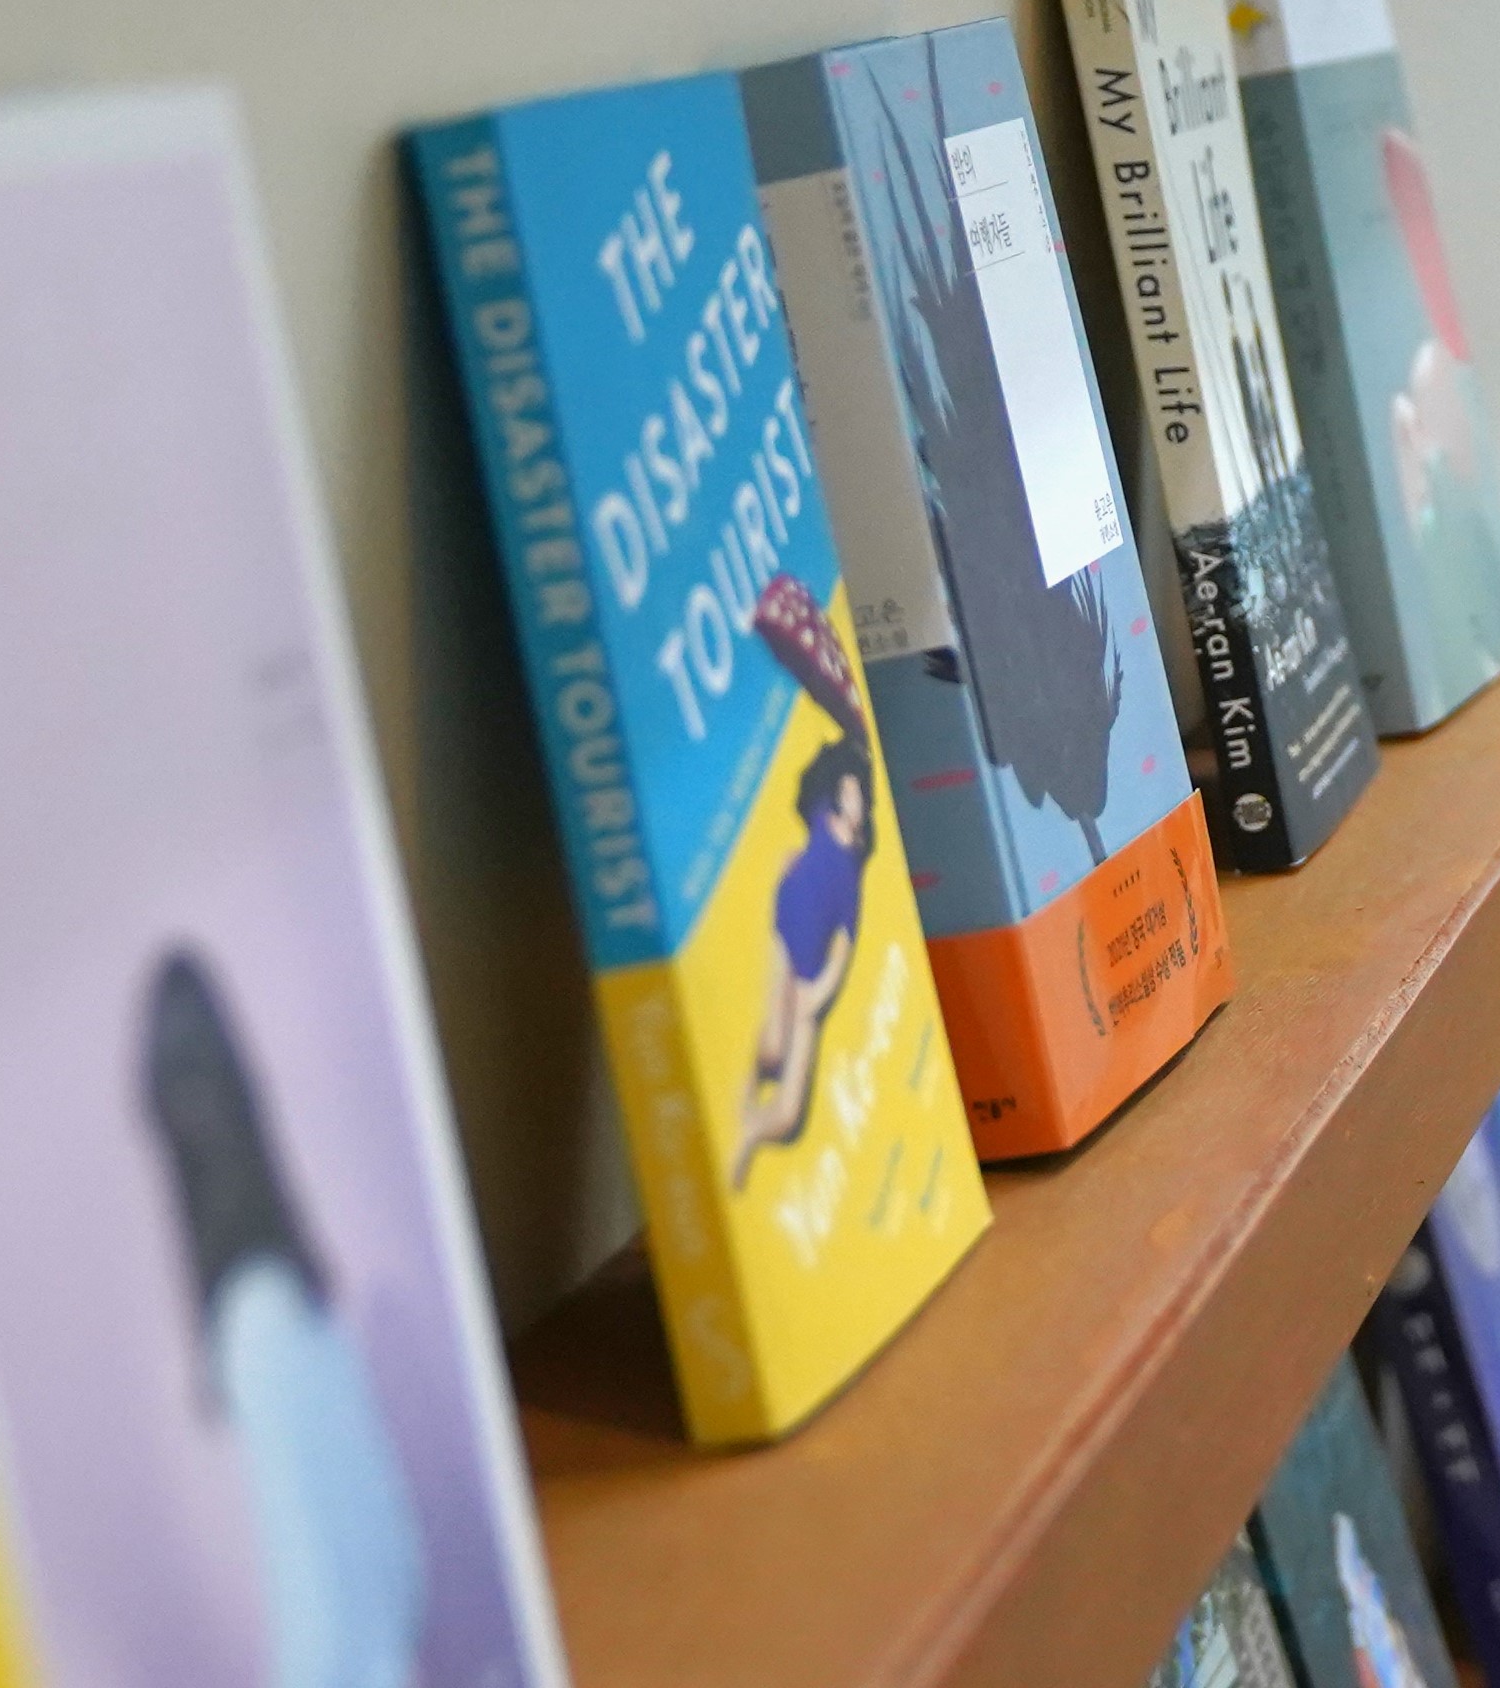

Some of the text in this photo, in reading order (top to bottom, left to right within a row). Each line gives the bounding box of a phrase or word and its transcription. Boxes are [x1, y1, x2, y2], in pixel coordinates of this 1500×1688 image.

[951, 145, 977, 186] 밤의
[1095, 68, 1137, 135] My
[448, 145, 519, 280] THE
[599, 149, 696, 346] THE
[969, 212, 1013, 258] 여행자들
[1114, 161, 1180, 346] Brilliant
[474, 298, 592, 626] DISASTER
[593, 222, 779, 611] DISASTER
[1153, 365, 1202, 445] Life
[658, 376, 813, 743] TOURIST
[1188, 549, 1234, 682] Ae-ran
[550, 642, 658, 930] TOURIST
[1218, 696, 1257, 770] Kim
